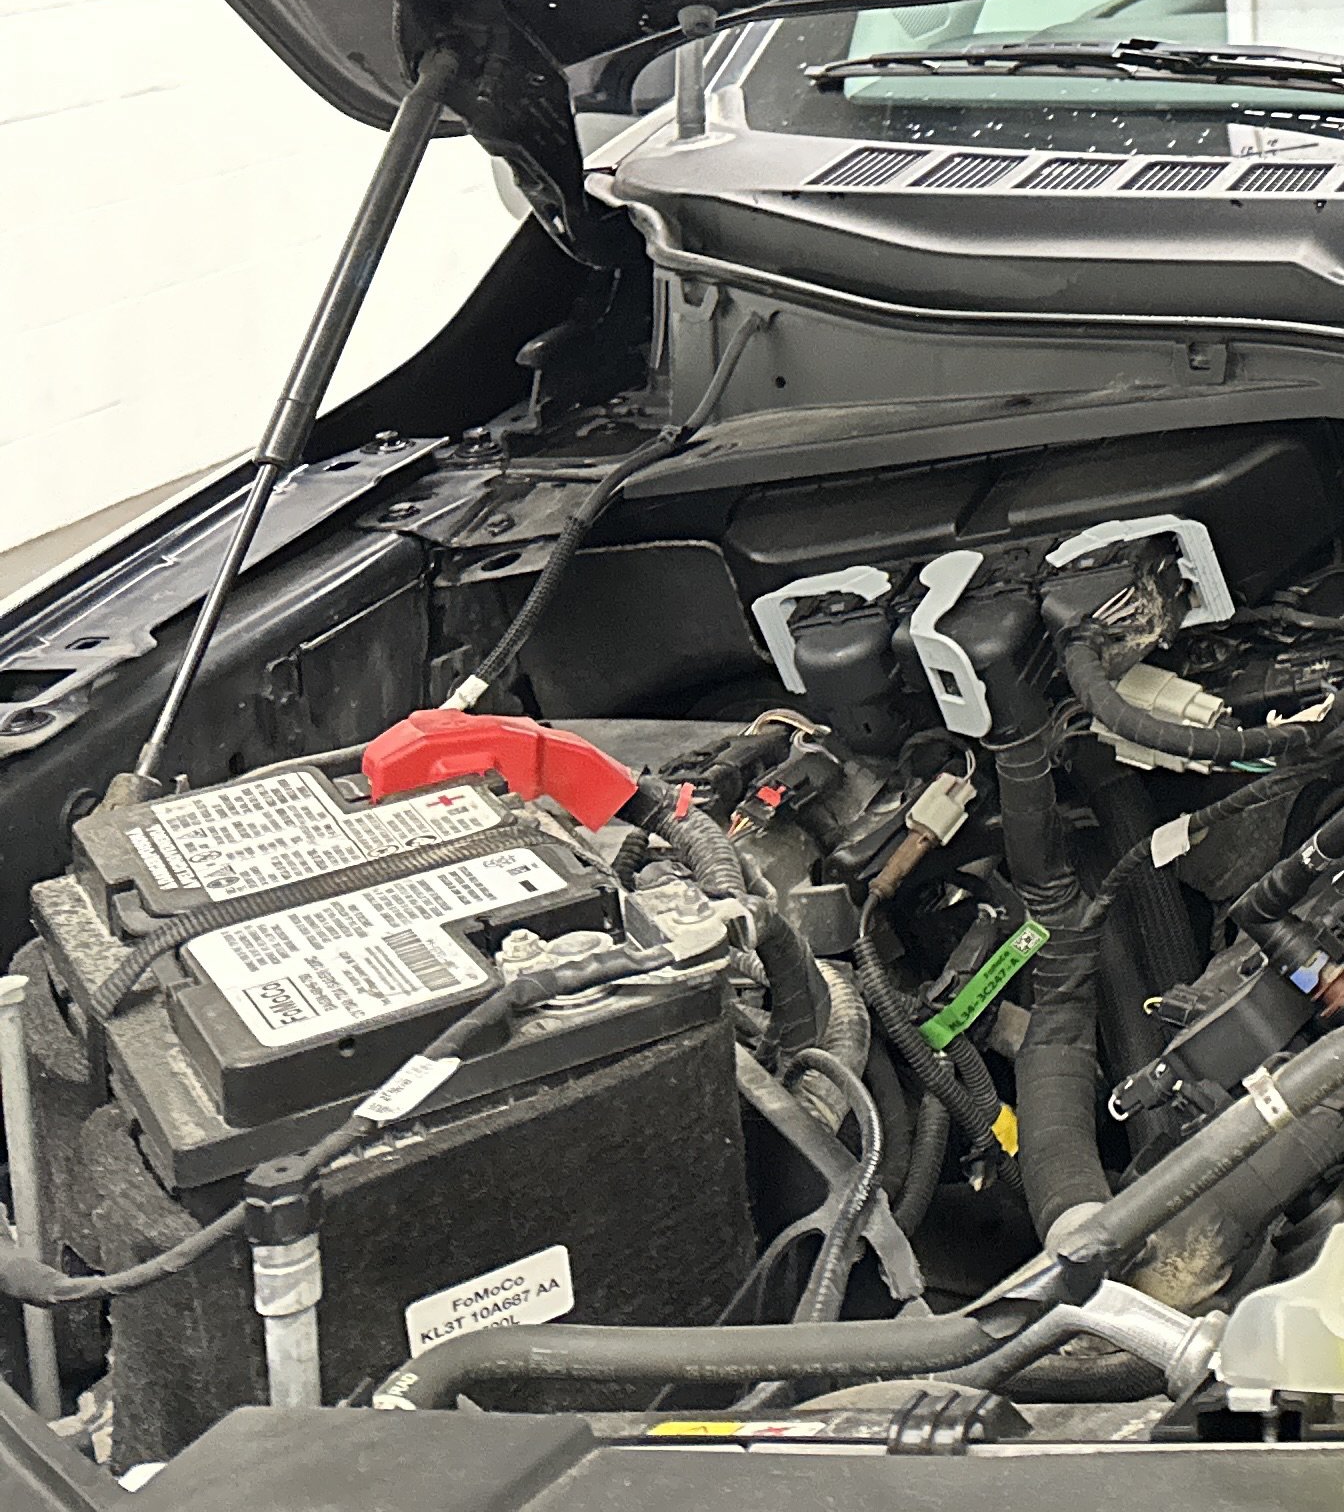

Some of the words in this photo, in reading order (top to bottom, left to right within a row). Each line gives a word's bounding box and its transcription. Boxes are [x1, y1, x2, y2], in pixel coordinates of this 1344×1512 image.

[259, 981, 310, 1026] FoMoCo
[420, 1315, 466, 1345] KL3T
[471, 1289, 531, 1324] 10A687
[535, 1277, 561, 1297] AA
[451, 1275, 526, 1313] FoMoCo
